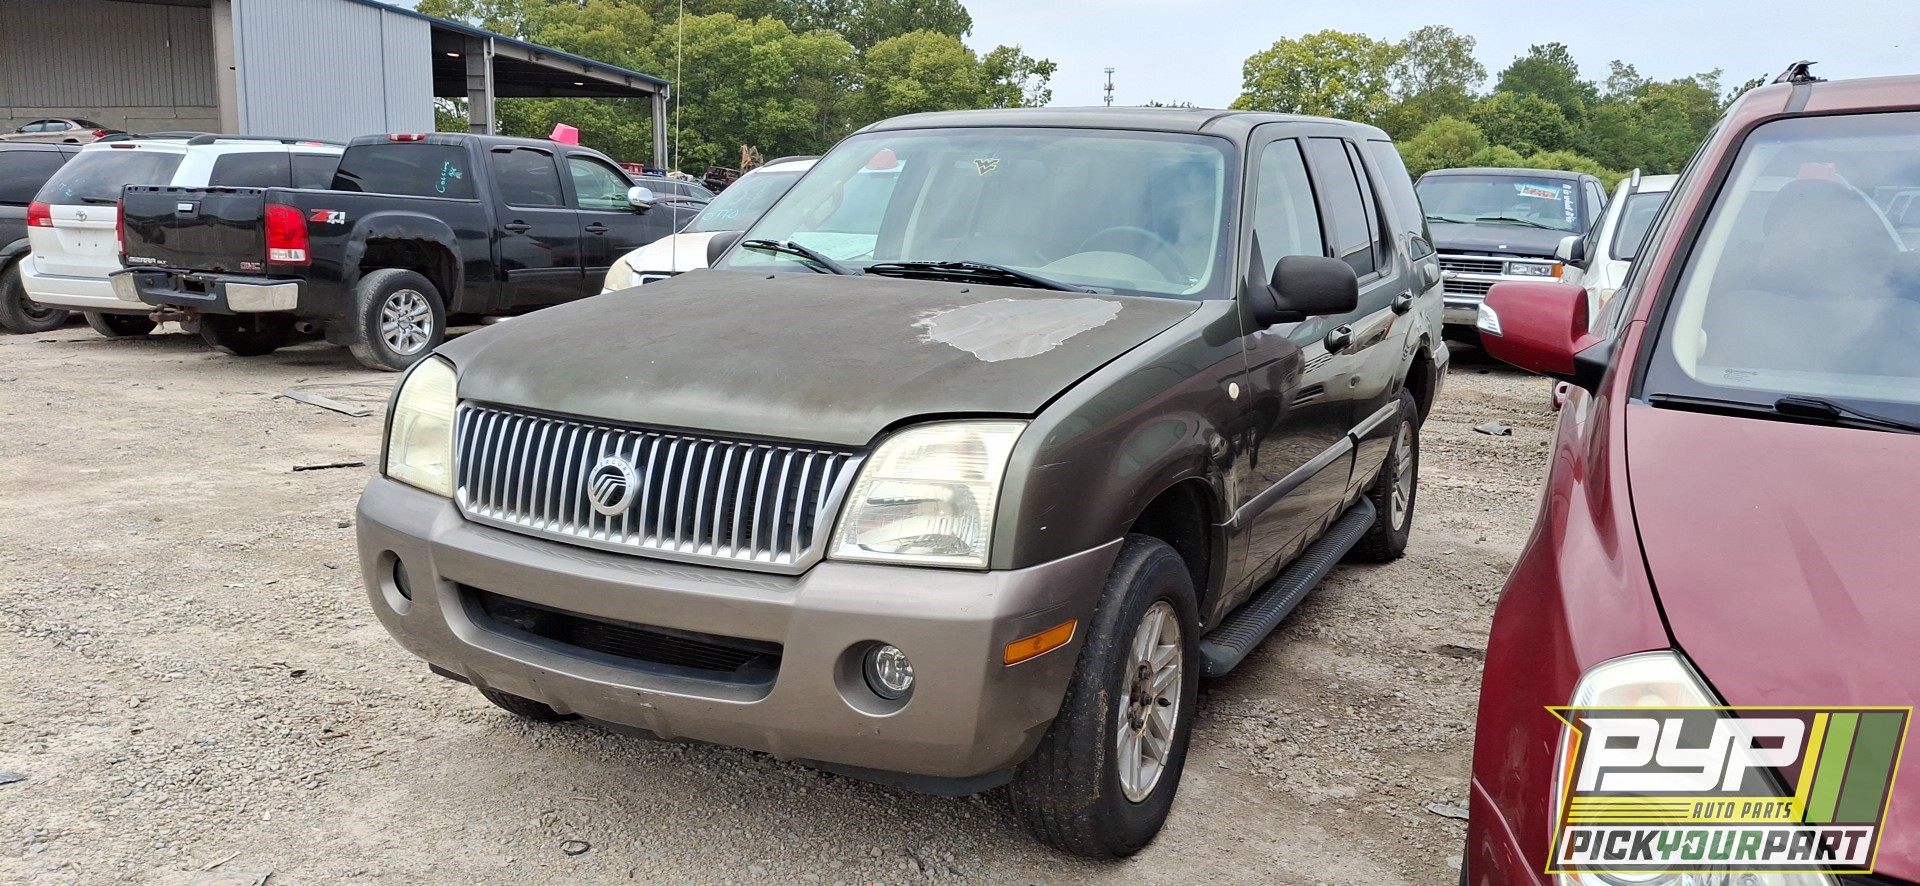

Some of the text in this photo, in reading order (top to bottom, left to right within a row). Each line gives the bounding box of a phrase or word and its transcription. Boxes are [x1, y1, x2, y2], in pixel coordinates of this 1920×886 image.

[310, 208, 346, 222] Z71
[239, 261, 261, 270] GMC
[593, 459, 632, 477] MERCURY
